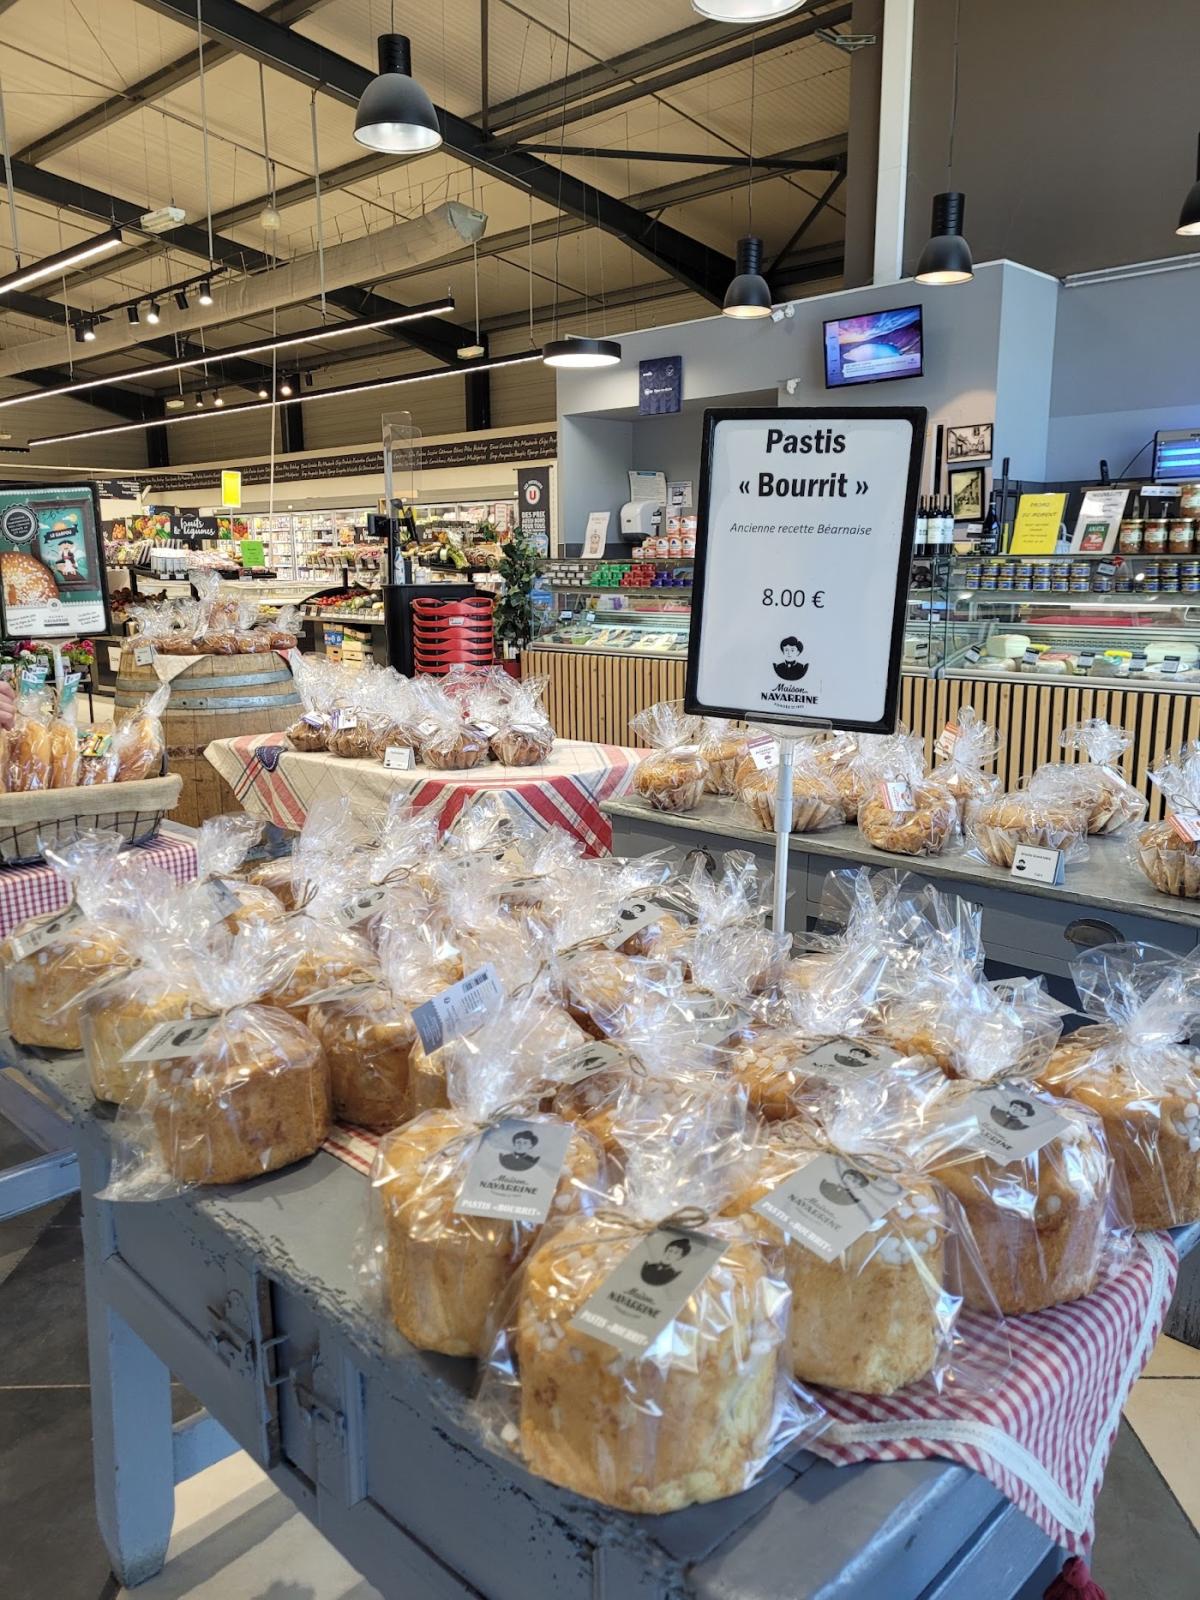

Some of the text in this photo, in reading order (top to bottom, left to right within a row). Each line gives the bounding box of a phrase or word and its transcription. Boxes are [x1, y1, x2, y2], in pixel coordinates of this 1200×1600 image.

[766, 429, 846, 454] Pastis
[759, 473, 848, 498] Bourrit
[529, 490, 537, 501] U
[180, 517, 205, 529] fruits
[730, 522, 873, 536] Ancienne recette Béarnaise
[183, 525, 216, 539] légumes
[762, 589, 806, 608] 8.00
[772, 683, 808, 694] Maison
[761, 692, 819, 704] NAVARRINE
[479, 1180, 538, 1195] NAVARRINE
[461, 1199, 491, 1209] PASTIS
[788, 1193, 842, 1232] NAVARRINE
[607, 1291, 661, 1319] NAVARRINE
